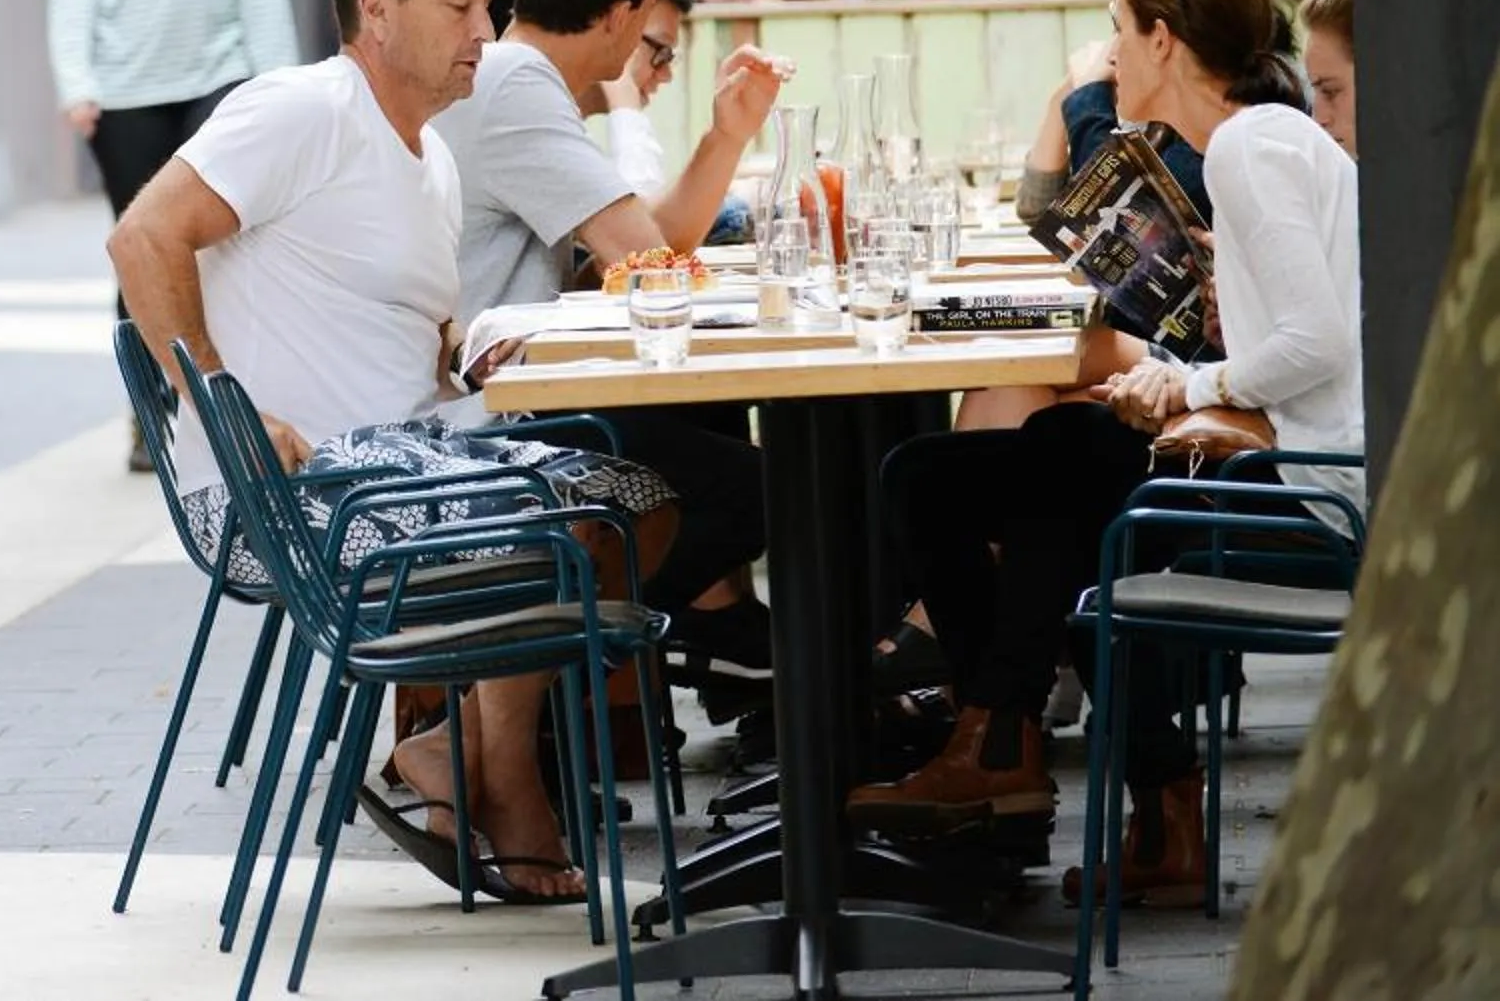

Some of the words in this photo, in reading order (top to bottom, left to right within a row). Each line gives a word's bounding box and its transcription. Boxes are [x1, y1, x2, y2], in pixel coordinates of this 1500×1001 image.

[948, 311, 972, 320] GIRL
[975, 310, 991, 319] ON
[994, 310, 1012, 318] THE
[1017, 310, 1047, 318] TRAIN
[981, 319, 1033, 327] HAWKINS
